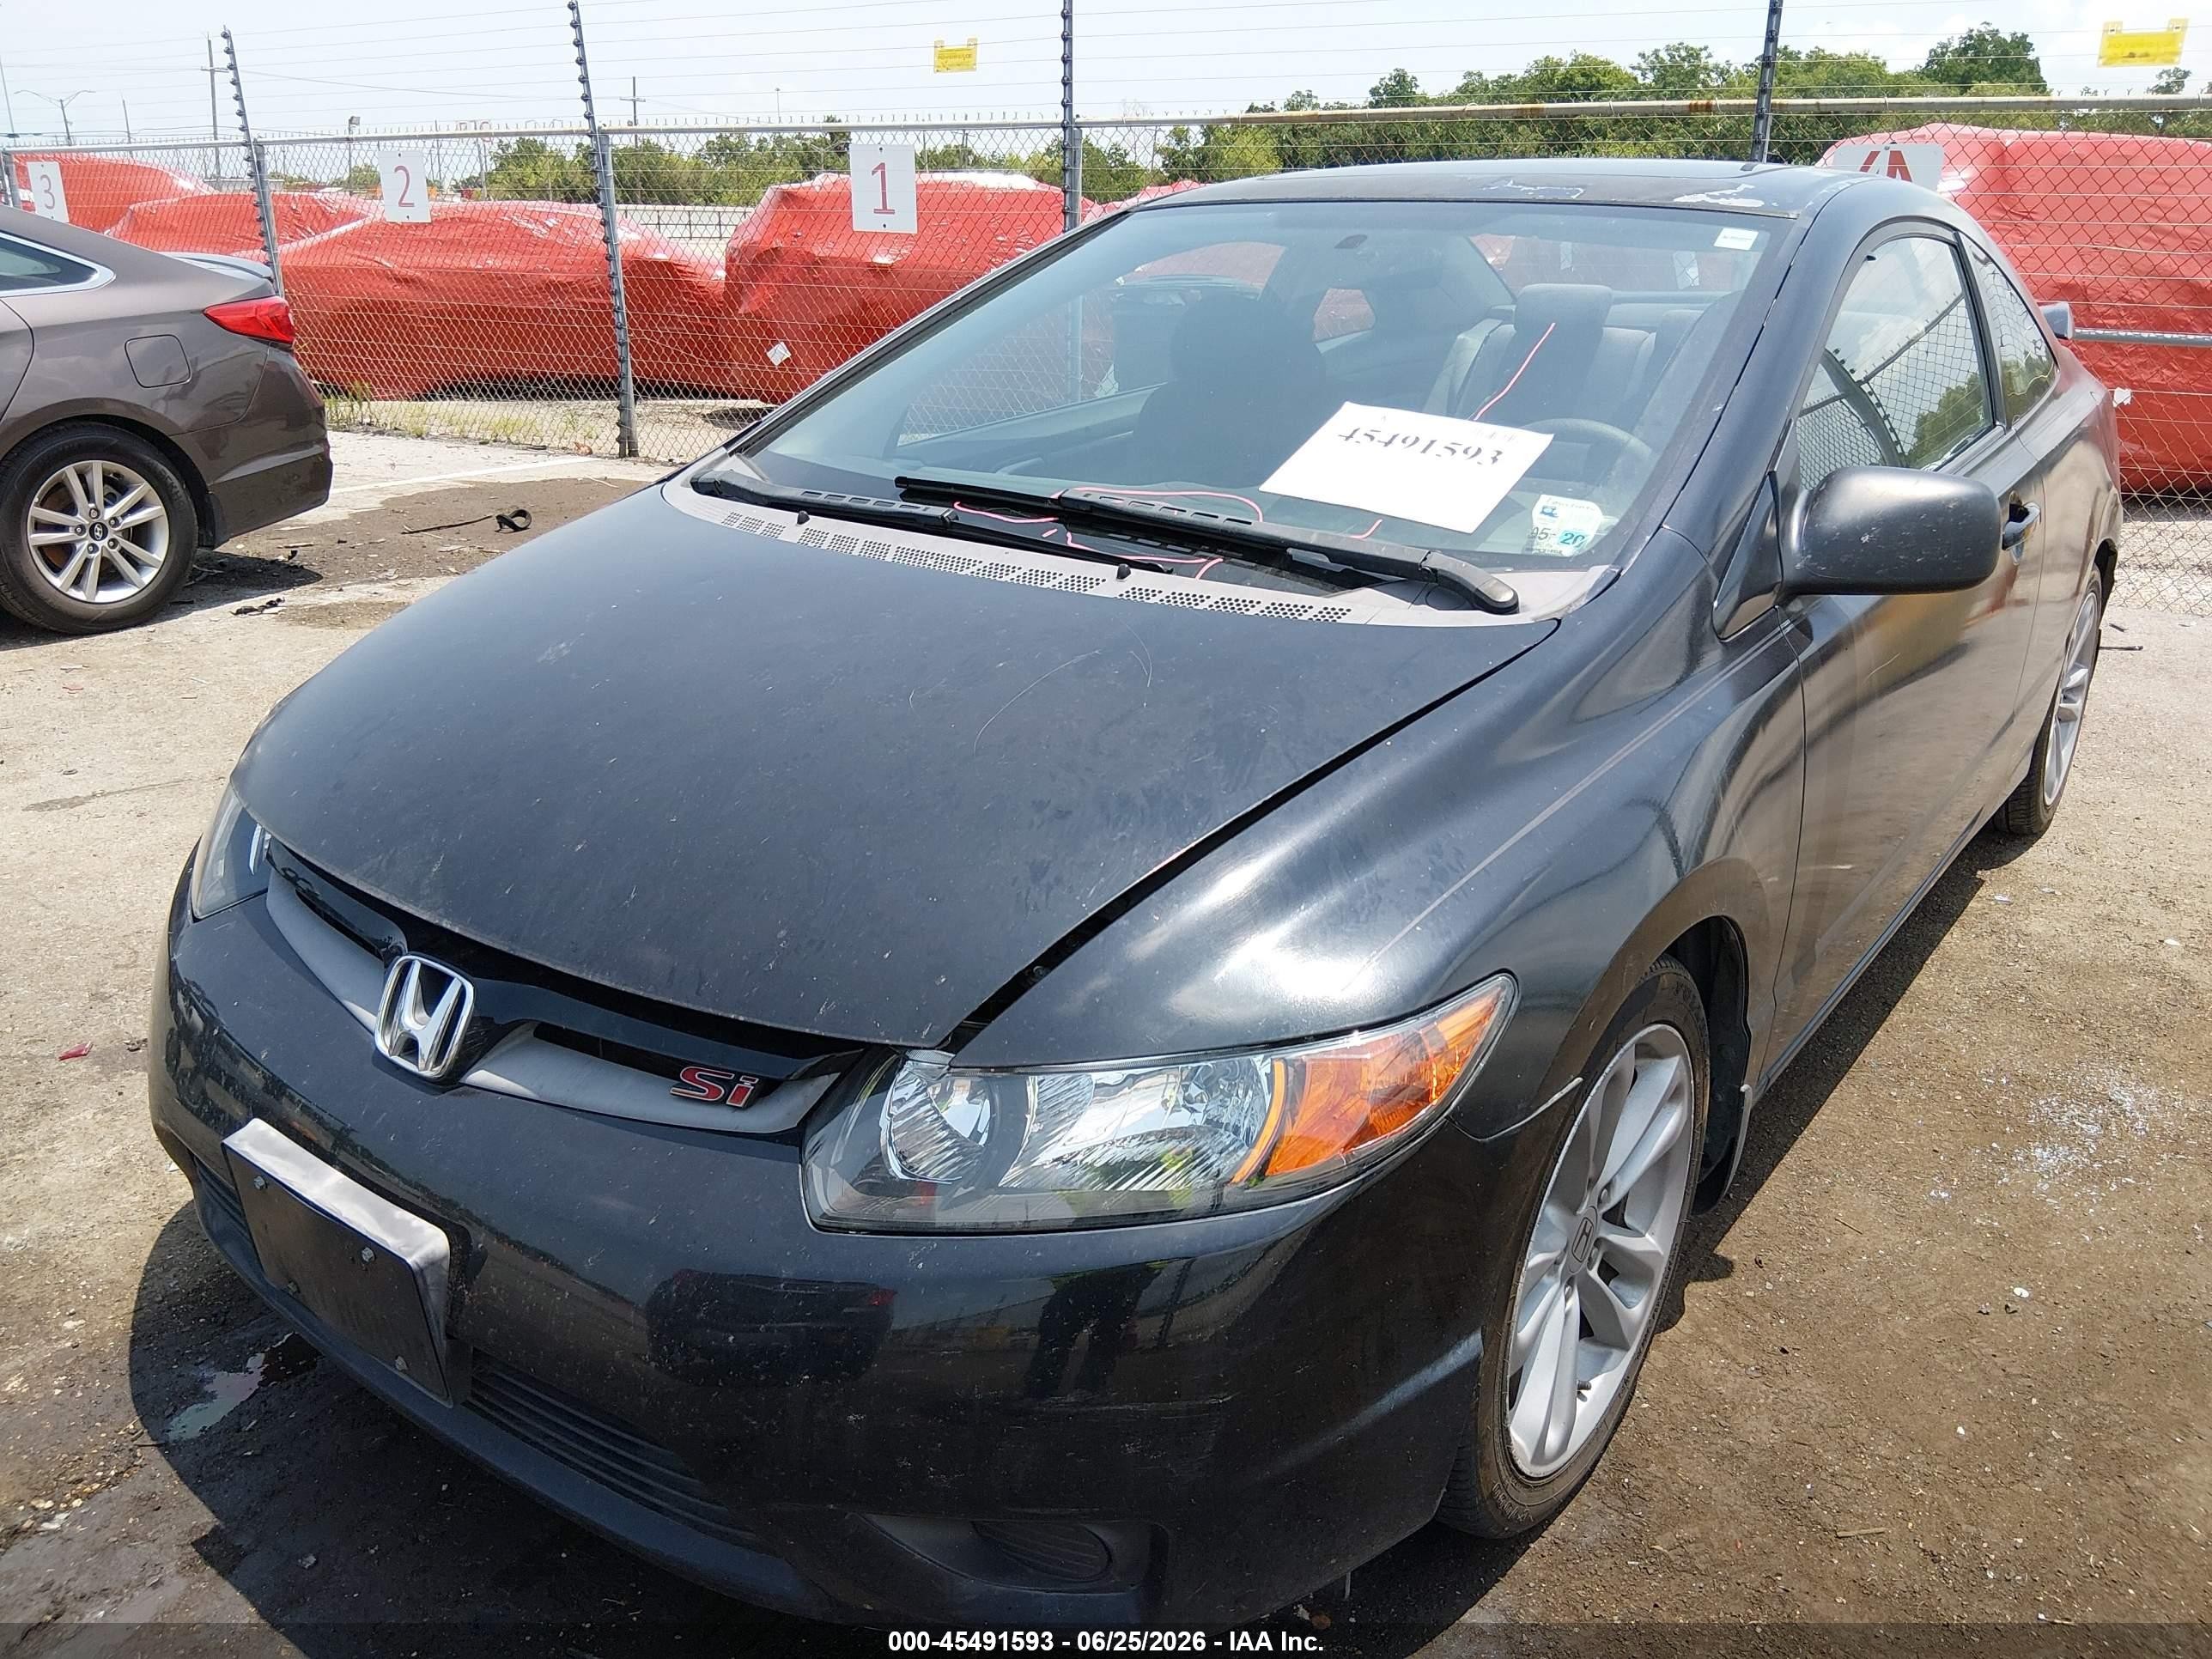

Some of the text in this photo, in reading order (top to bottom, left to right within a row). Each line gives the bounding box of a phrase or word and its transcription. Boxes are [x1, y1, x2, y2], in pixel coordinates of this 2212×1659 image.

[40, 173, 55, 210] 3
[394, 165, 415, 208] 2
[871, 162, 896, 215] 1
[1337, 427, 1504, 465] 45491593
[670, 1066, 759, 1108] Si
